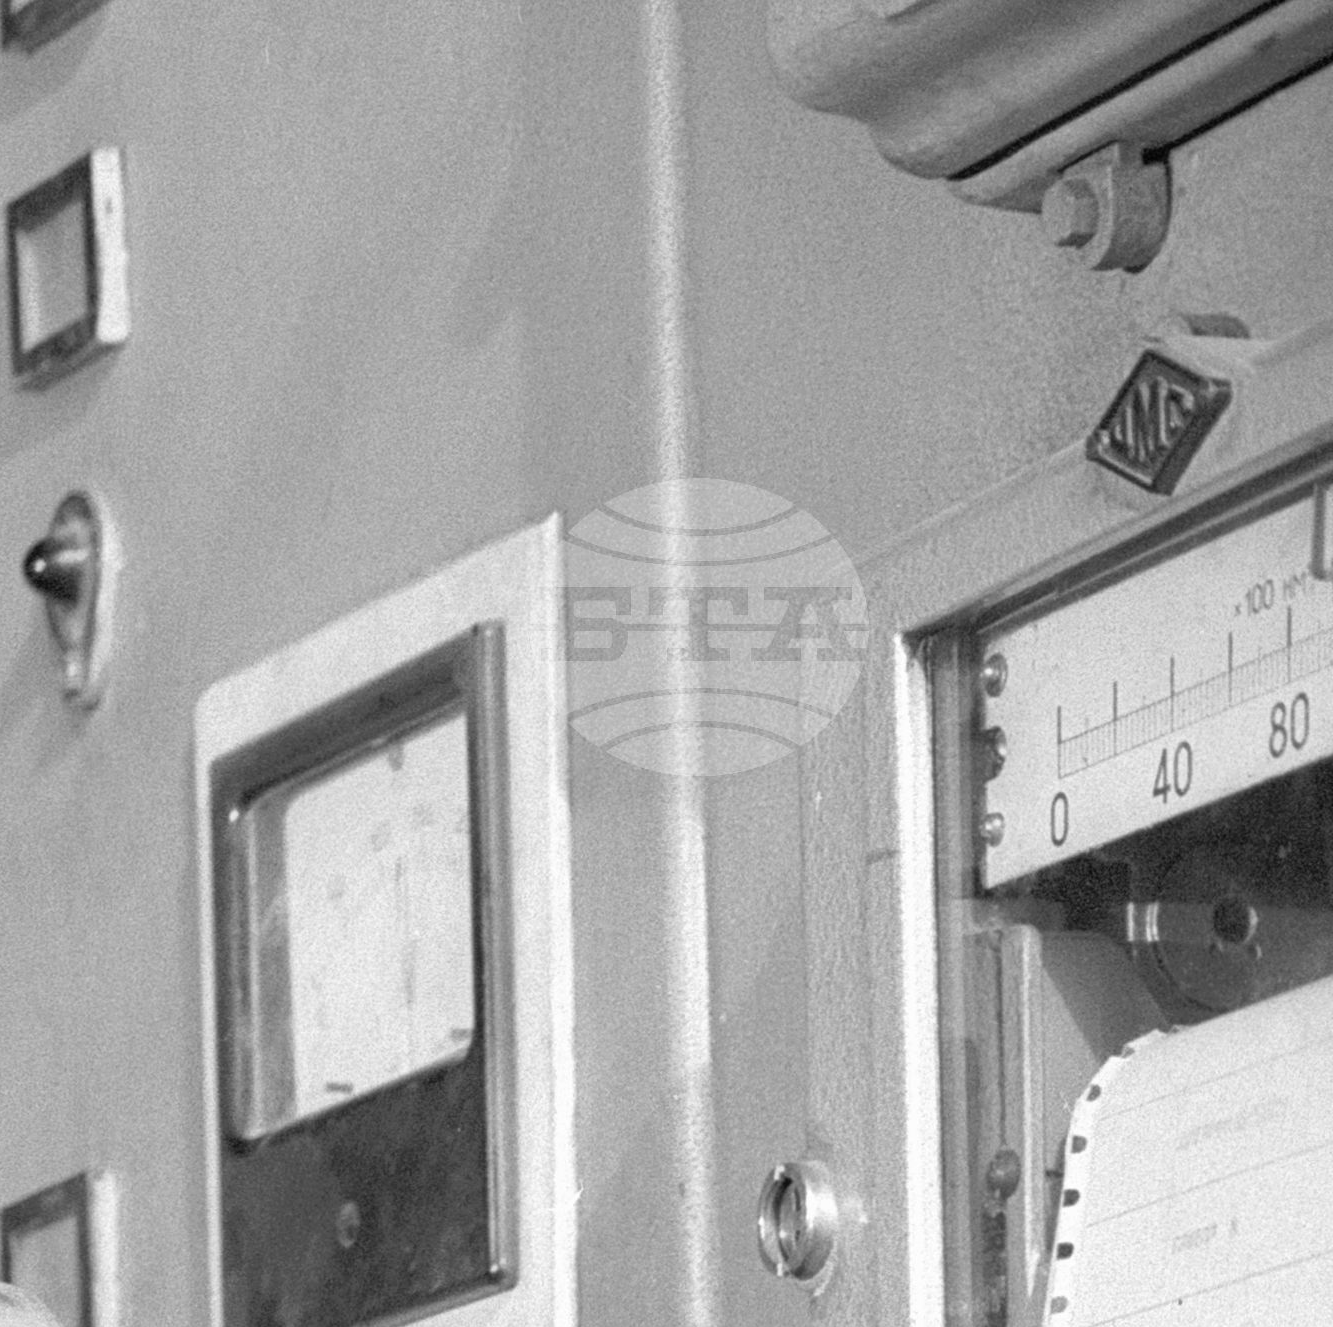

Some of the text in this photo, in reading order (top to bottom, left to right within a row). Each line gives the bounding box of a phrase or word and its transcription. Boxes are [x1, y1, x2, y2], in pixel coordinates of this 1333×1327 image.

[1050, 692, 1311, 847] 0 40 80
